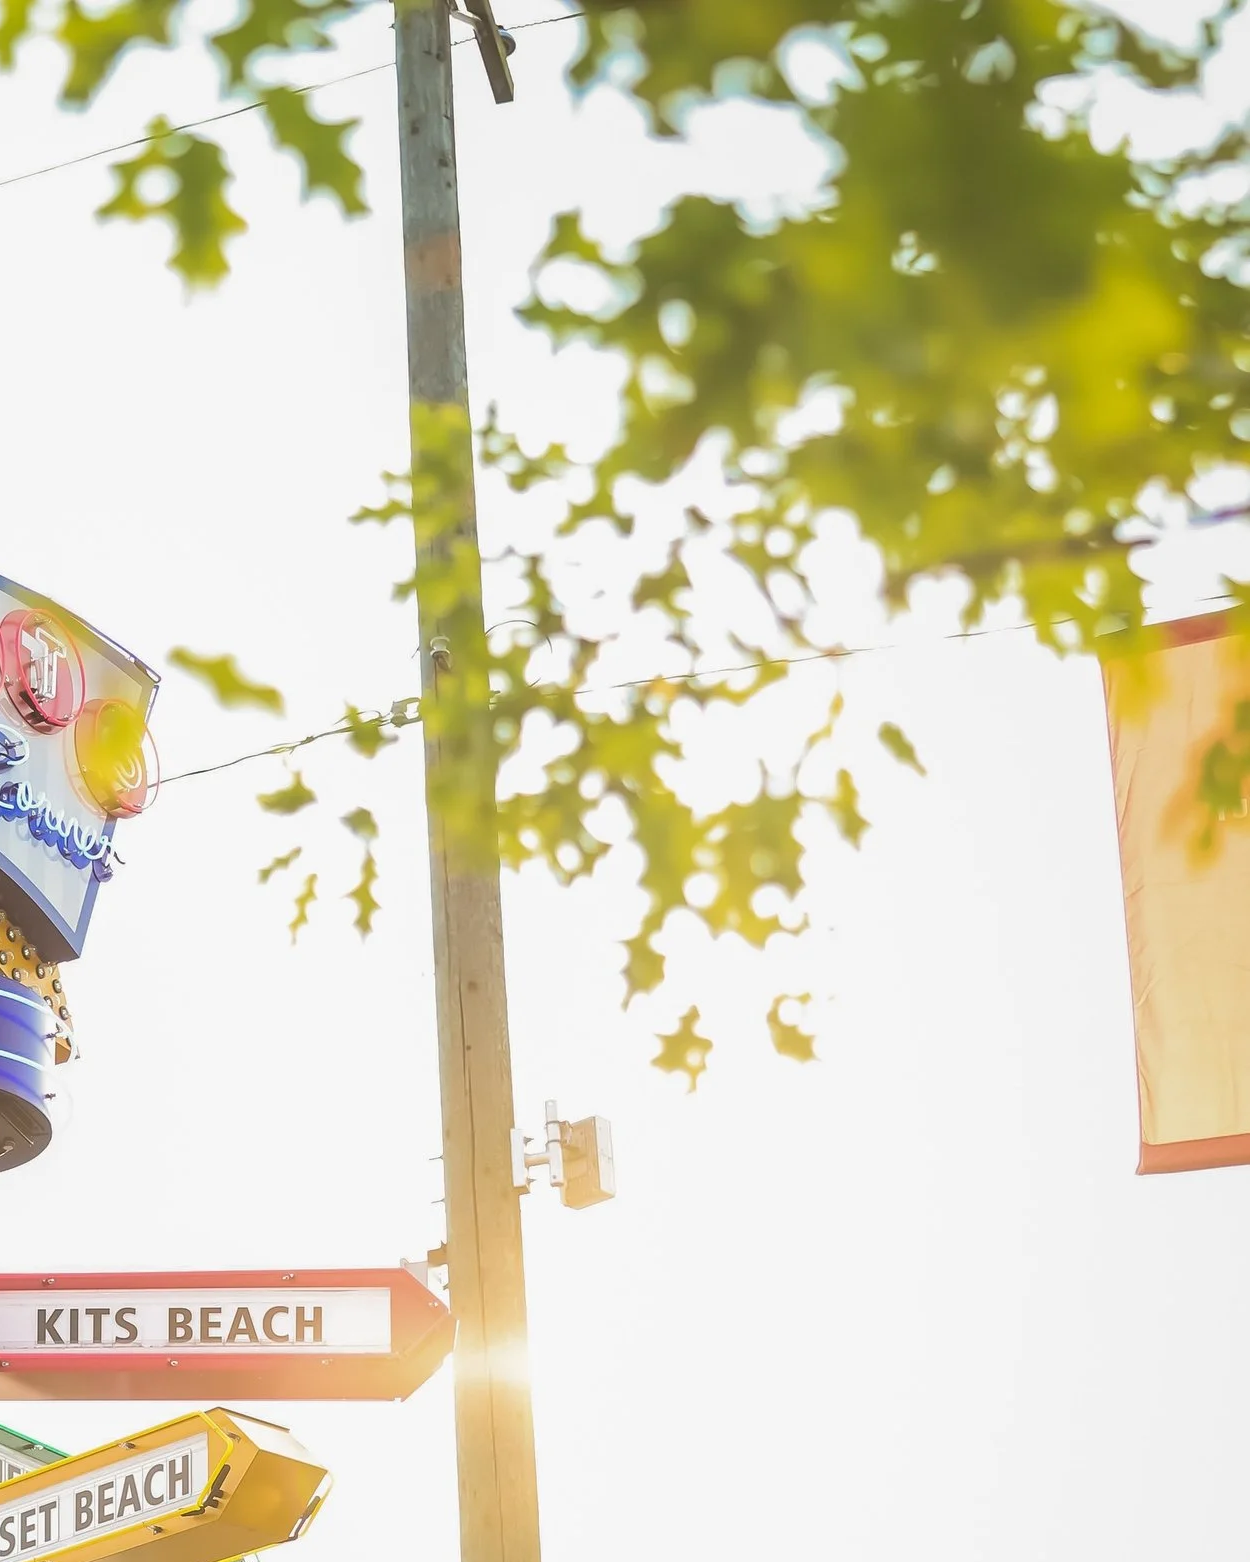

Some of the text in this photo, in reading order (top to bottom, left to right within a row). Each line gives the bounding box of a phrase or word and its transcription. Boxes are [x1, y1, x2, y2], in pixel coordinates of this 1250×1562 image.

[36, 1305, 324, 1346] KITS BEACH
[73, 1453, 191, 1533] BEACH
